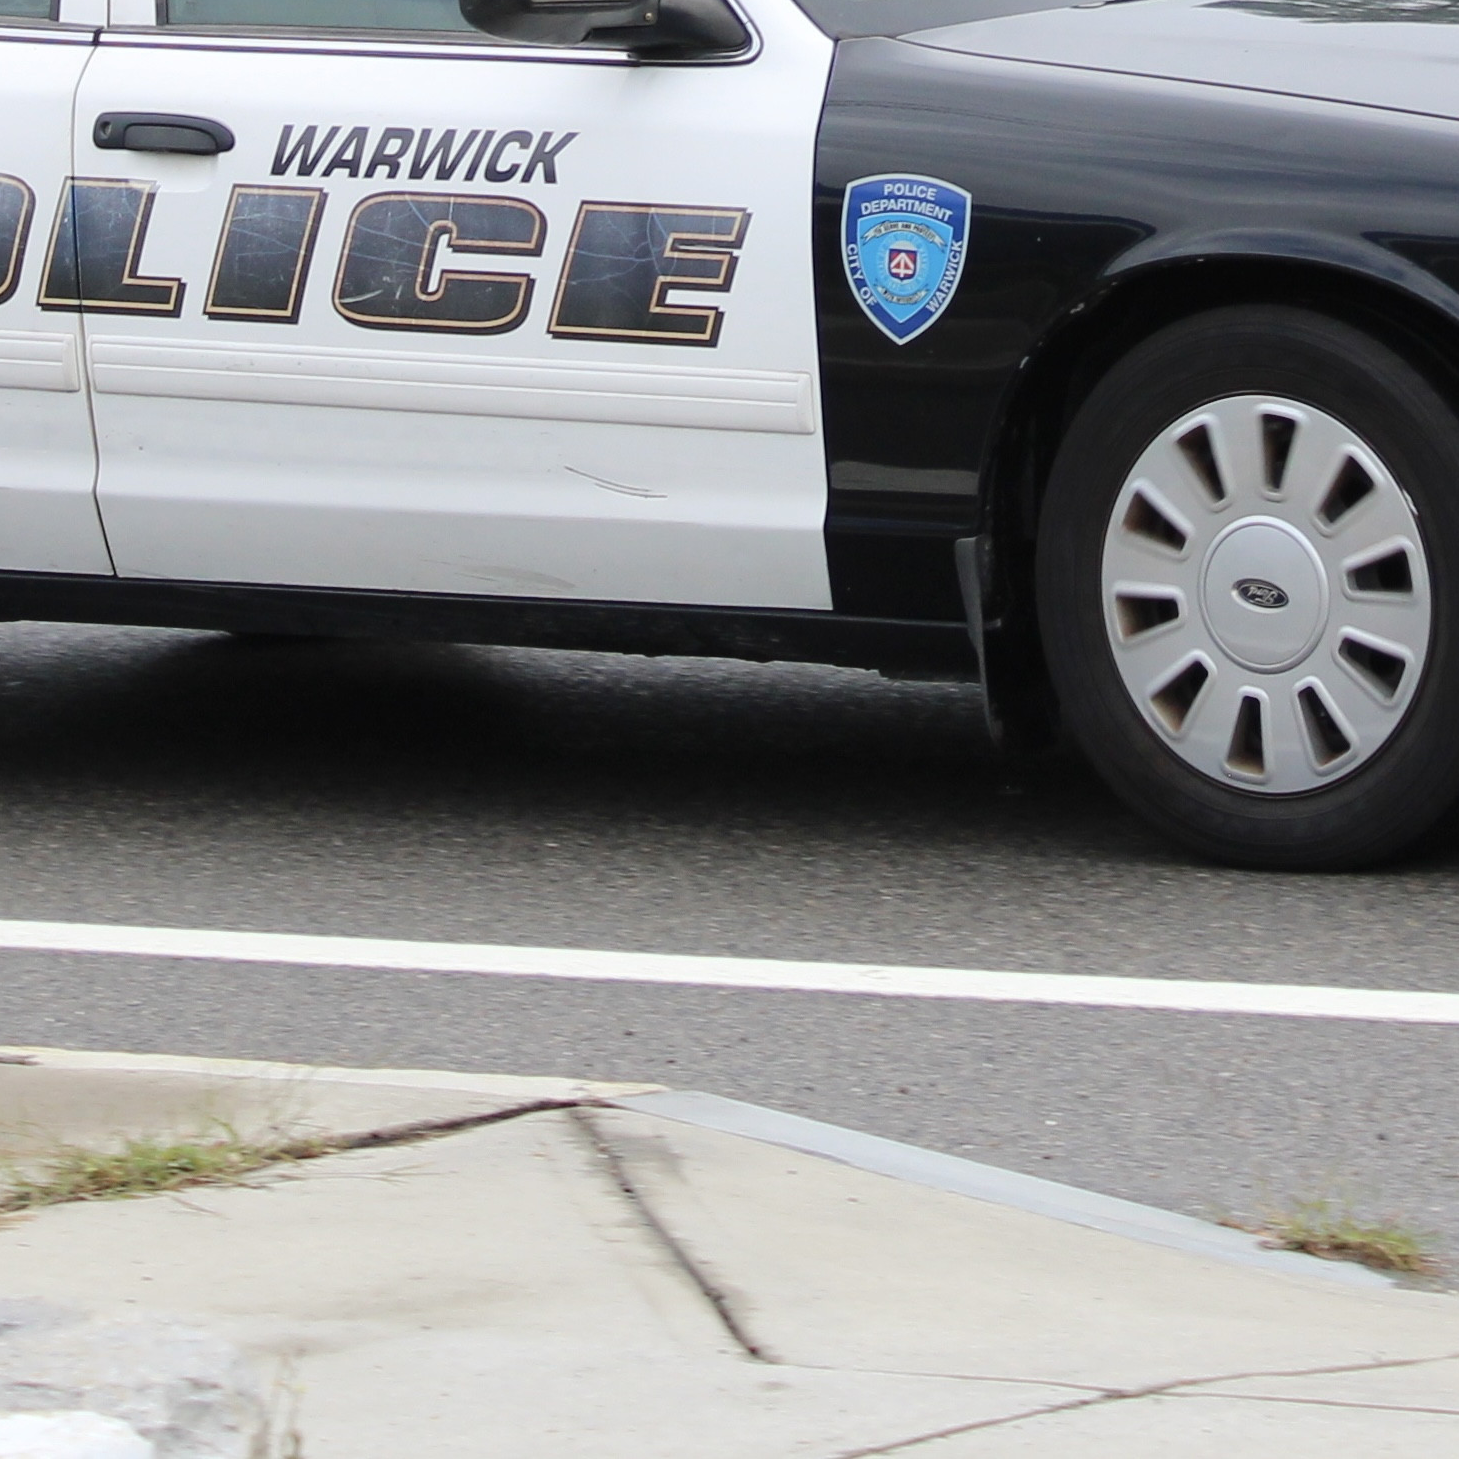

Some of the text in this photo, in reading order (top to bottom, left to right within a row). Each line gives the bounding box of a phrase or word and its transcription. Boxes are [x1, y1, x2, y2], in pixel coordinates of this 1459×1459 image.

[270, 124, 580, 184] WARWICK
[861, 199, 953, 222] DEPARTMENT
[884, 183, 937, 200] POLICE
[847, 243, 878, 307] CITY OF
[926, 240, 963, 314] WARWICK
[1247, 586, 1278, 604] Ford
